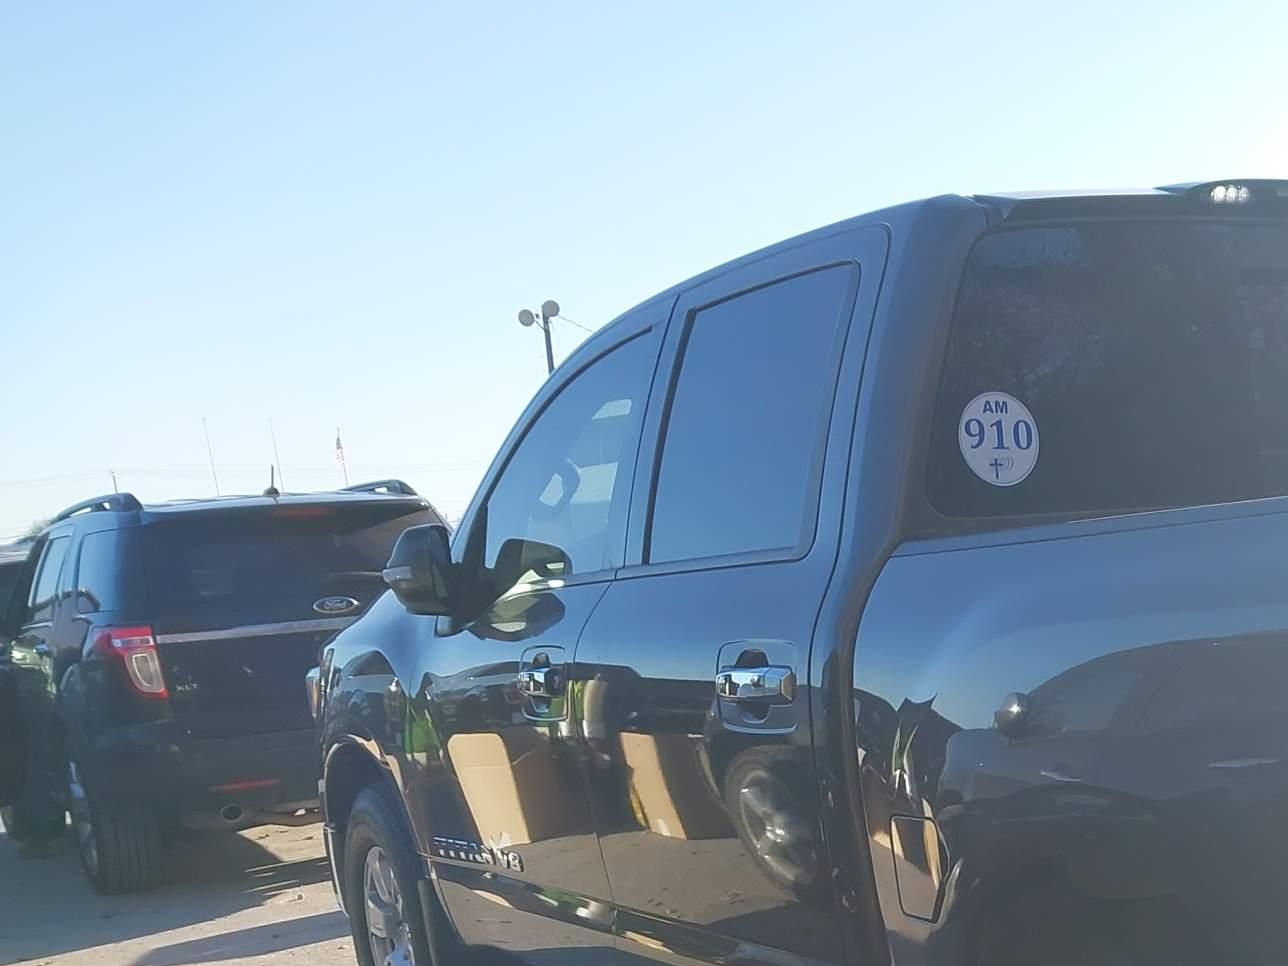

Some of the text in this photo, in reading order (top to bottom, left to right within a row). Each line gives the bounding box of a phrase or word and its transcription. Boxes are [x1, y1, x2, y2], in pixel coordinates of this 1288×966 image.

[982, 400, 1009, 415] AM
[964, 418, 1033, 450] 910
[432, 836, 497, 866] TITAN
